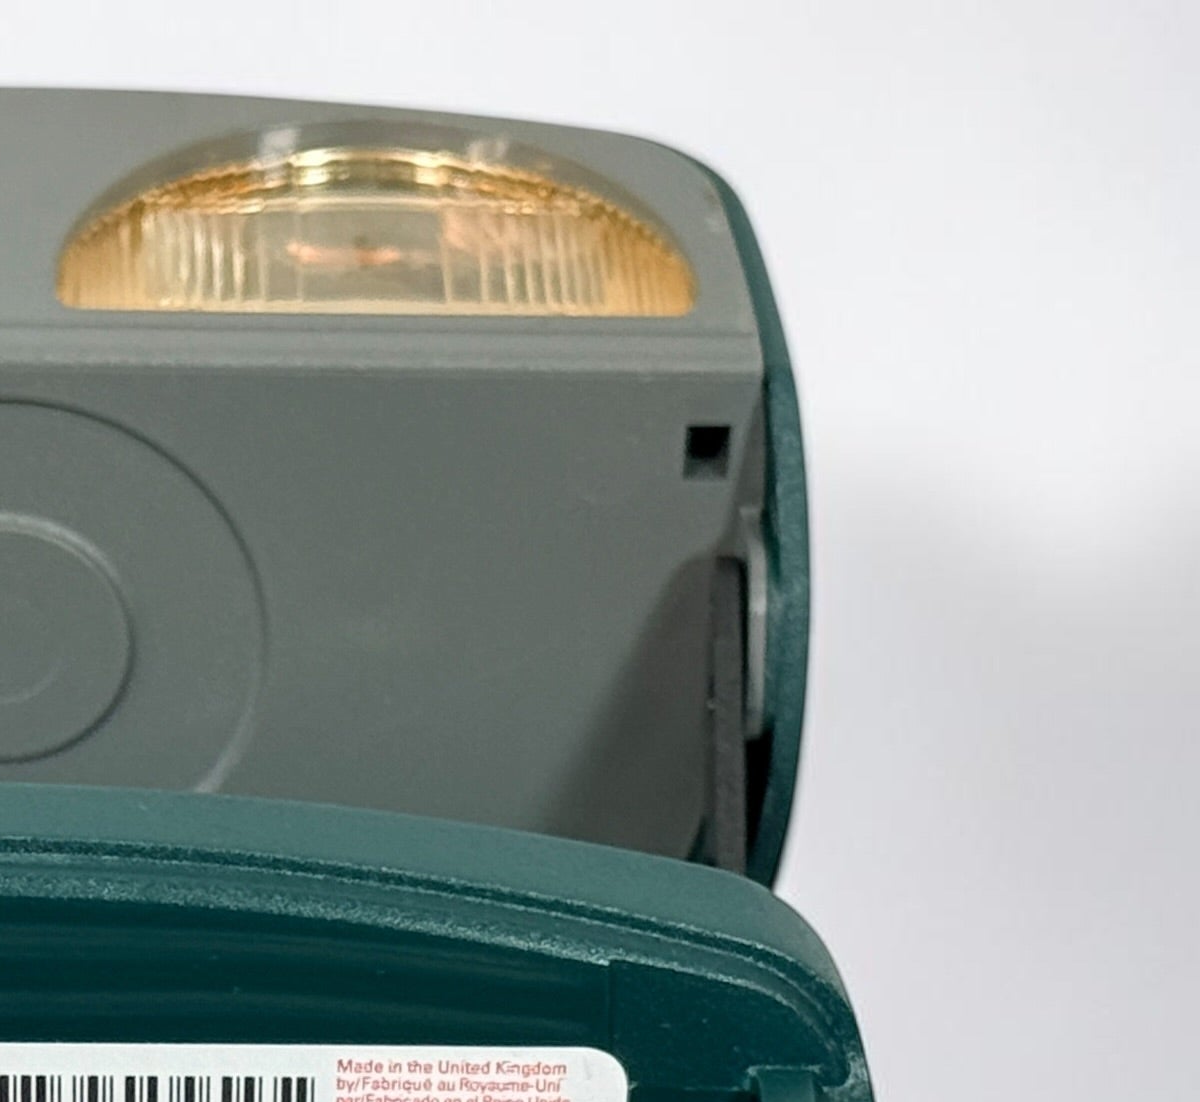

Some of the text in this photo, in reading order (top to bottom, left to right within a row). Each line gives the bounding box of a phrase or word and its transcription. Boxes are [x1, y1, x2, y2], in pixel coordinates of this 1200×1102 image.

[337, 1059, 567, 1077] Made in the United Kingdom
[437, 1080, 455, 1092] au
[460, 1078, 562, 1095] Royaume-Uni
